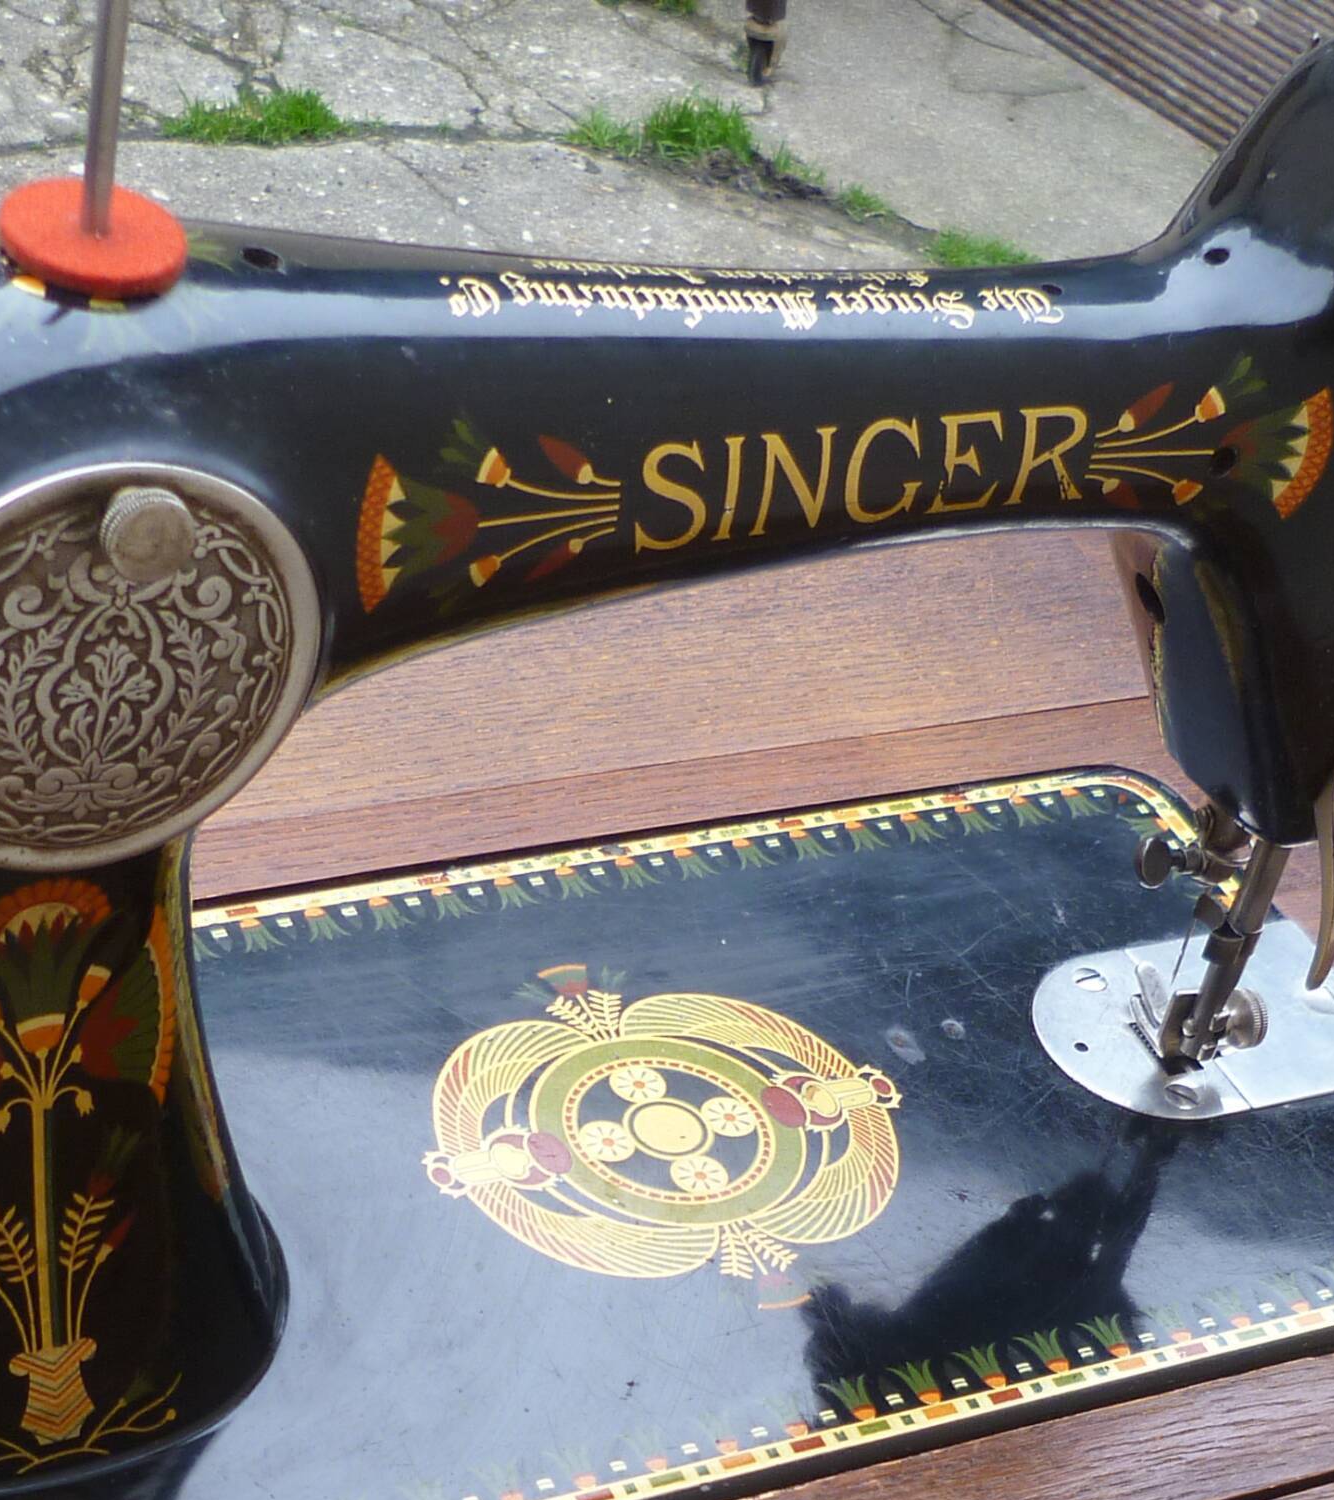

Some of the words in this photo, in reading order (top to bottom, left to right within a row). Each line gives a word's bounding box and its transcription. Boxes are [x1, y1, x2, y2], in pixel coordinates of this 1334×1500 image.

[499, 272, 817, 331] Manufacturing
[826, 286, 975, 329] Singer
[979, 286, 1064, 325] The
[634, 405, 1089, 554] SINGER
